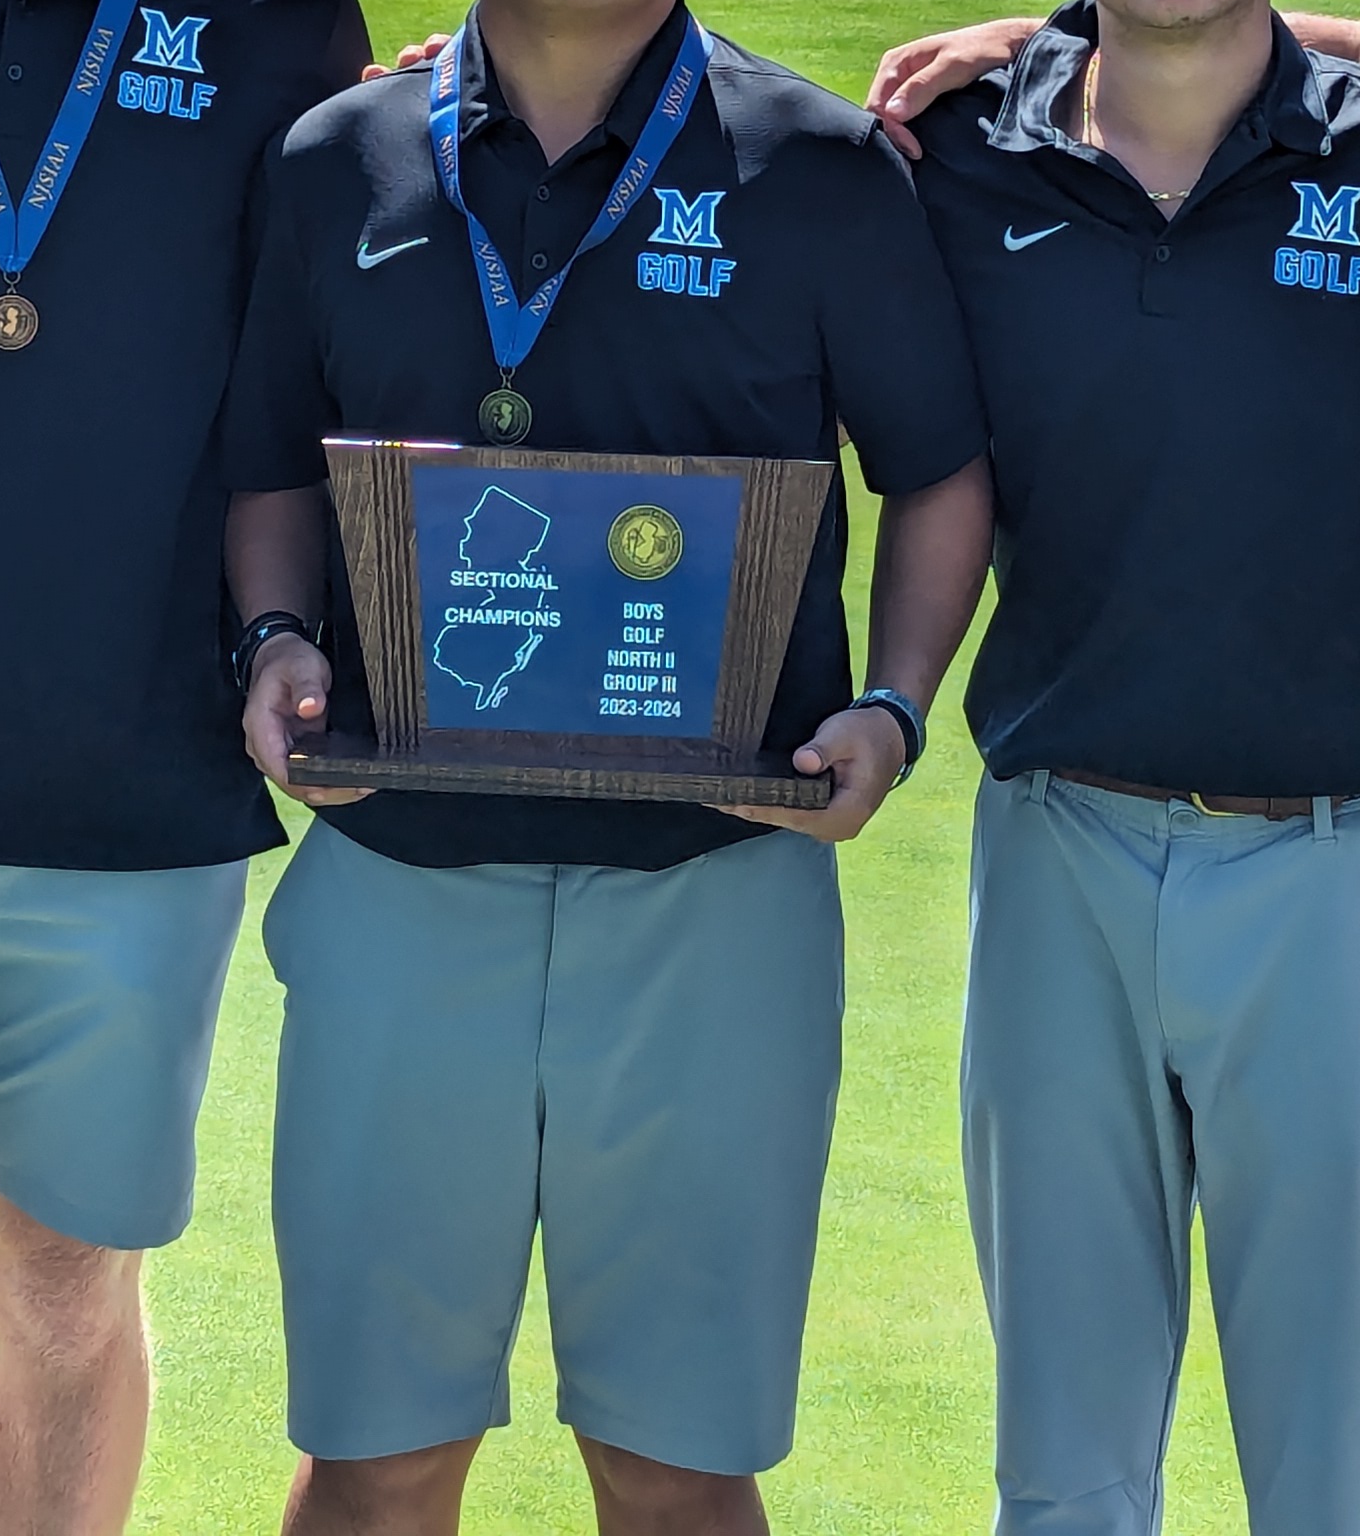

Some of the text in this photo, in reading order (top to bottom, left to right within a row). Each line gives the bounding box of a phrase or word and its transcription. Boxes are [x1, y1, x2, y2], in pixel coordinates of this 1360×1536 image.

[76, 27, 114, 96] NJSIAA
[131, 6, 211, 74] M
[117, 71, 218, 120] GOLF
[661, 64, 693, 121] NJSIAA
[27, 141, 70, 209] NJSIAA
[607, 156, 649, 220] NJSIAA
[647, 187, 727, 249] M
[476, 241, 510, 307] NJSIAA
[637, 252, 737, 298] GOLF
[450, 570, 559, 590] SECTIONAL
[444, 607, 561, 628] CHAMPIONS
[623, 602, 664, 620] BOYS
[623, 626, 665, 644] GOLF
[607, 649, 675, 669] NORTH II
[603, 673, 677, 693] GROUP III
[599, 697, 681, 718] 2023-2024
